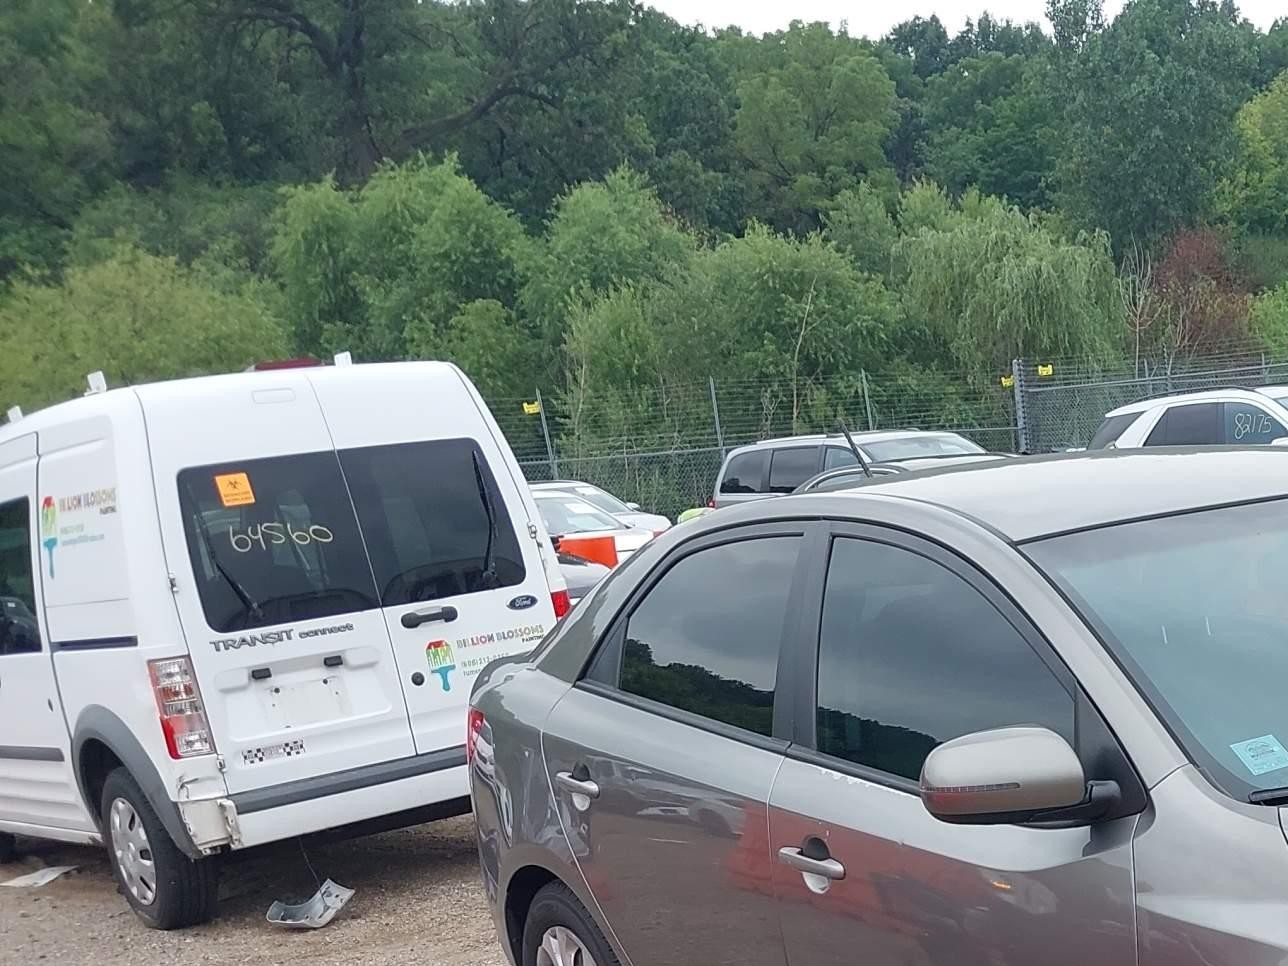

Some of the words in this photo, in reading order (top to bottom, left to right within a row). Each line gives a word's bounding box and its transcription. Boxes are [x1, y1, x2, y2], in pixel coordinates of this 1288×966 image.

[1233, 412, 1273, 440] 82175
[229, 522, 334, 552] 64560
[209, 628, 294, 652] TRANSIT
[298, 622, 354, 639] connect
[496, 624, 544, 640] BLOSSOMS
